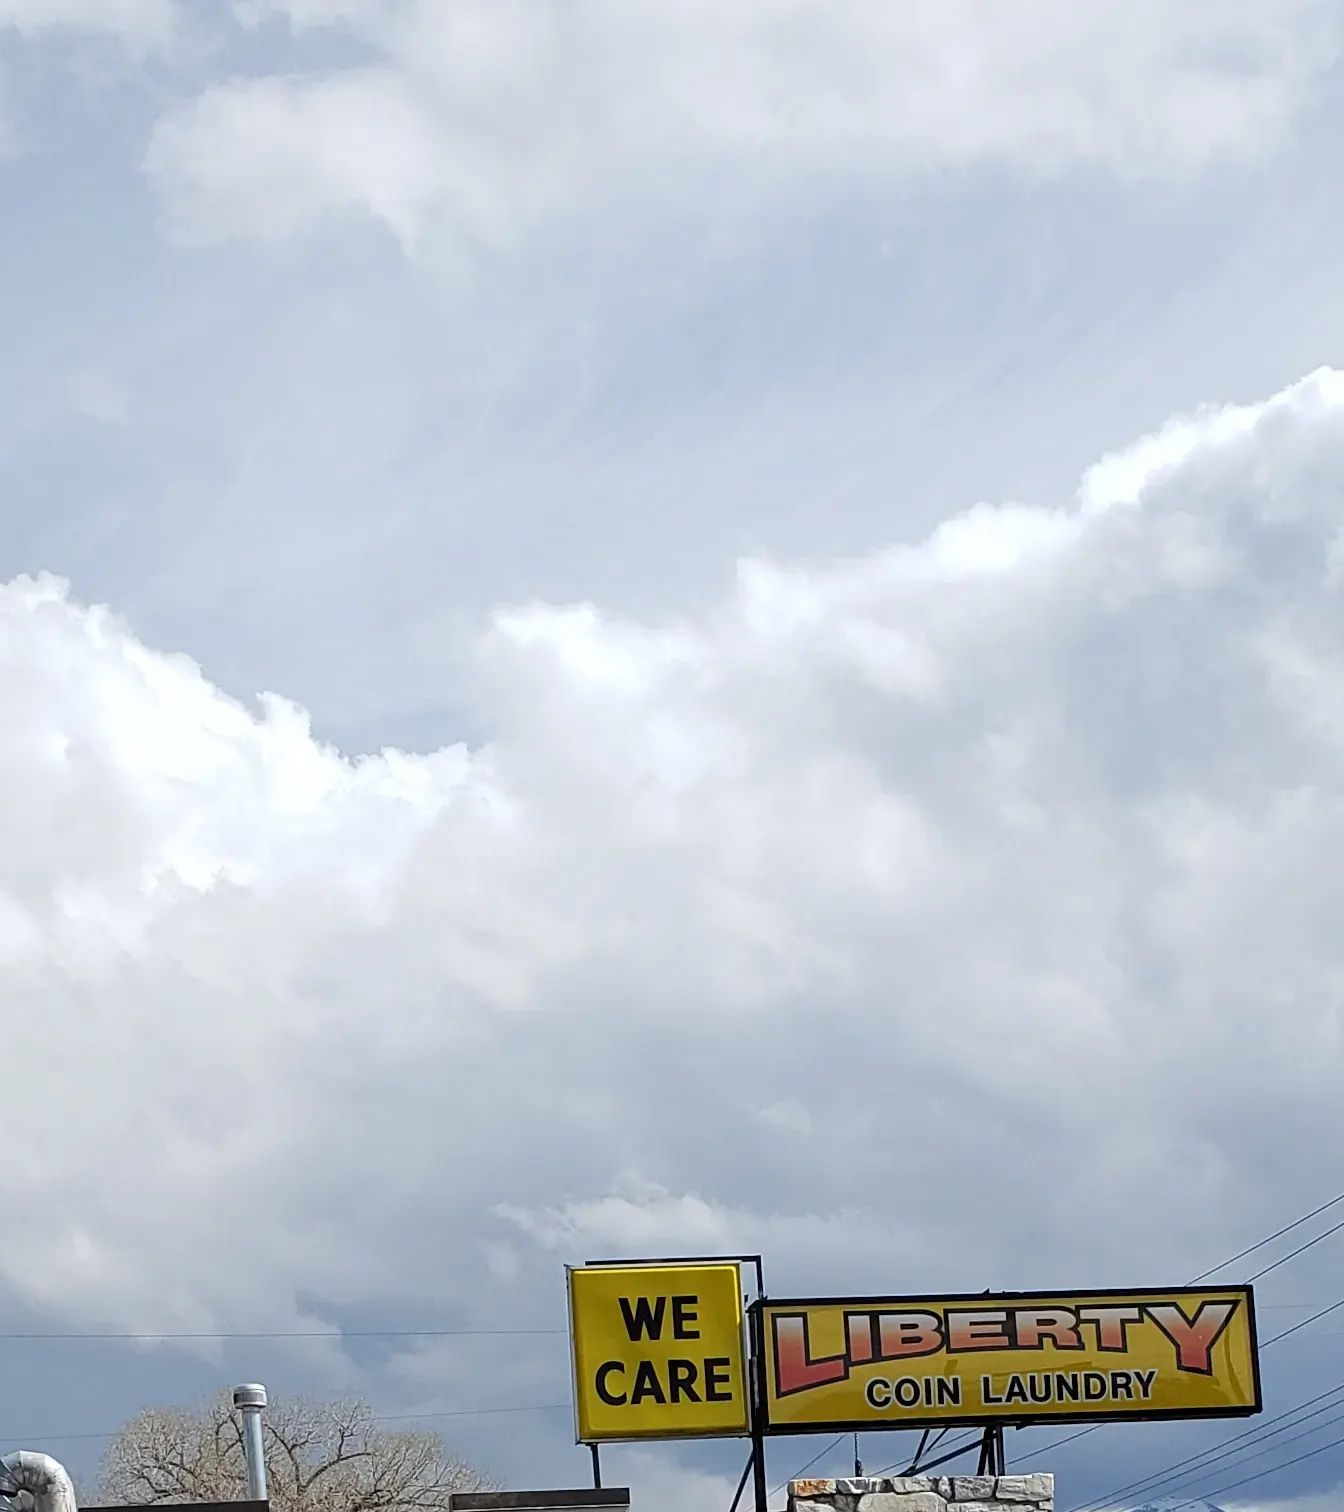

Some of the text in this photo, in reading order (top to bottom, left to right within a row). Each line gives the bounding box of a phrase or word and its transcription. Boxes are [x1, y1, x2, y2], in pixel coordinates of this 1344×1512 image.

[618, 1295, 701, 1342] WE
[771, 1299, 1241, 1398] LIBERTY
[595, 1357, 733, 1406] CARE
[866, 1370, 1157, 1408] COIN LAUNDRY
